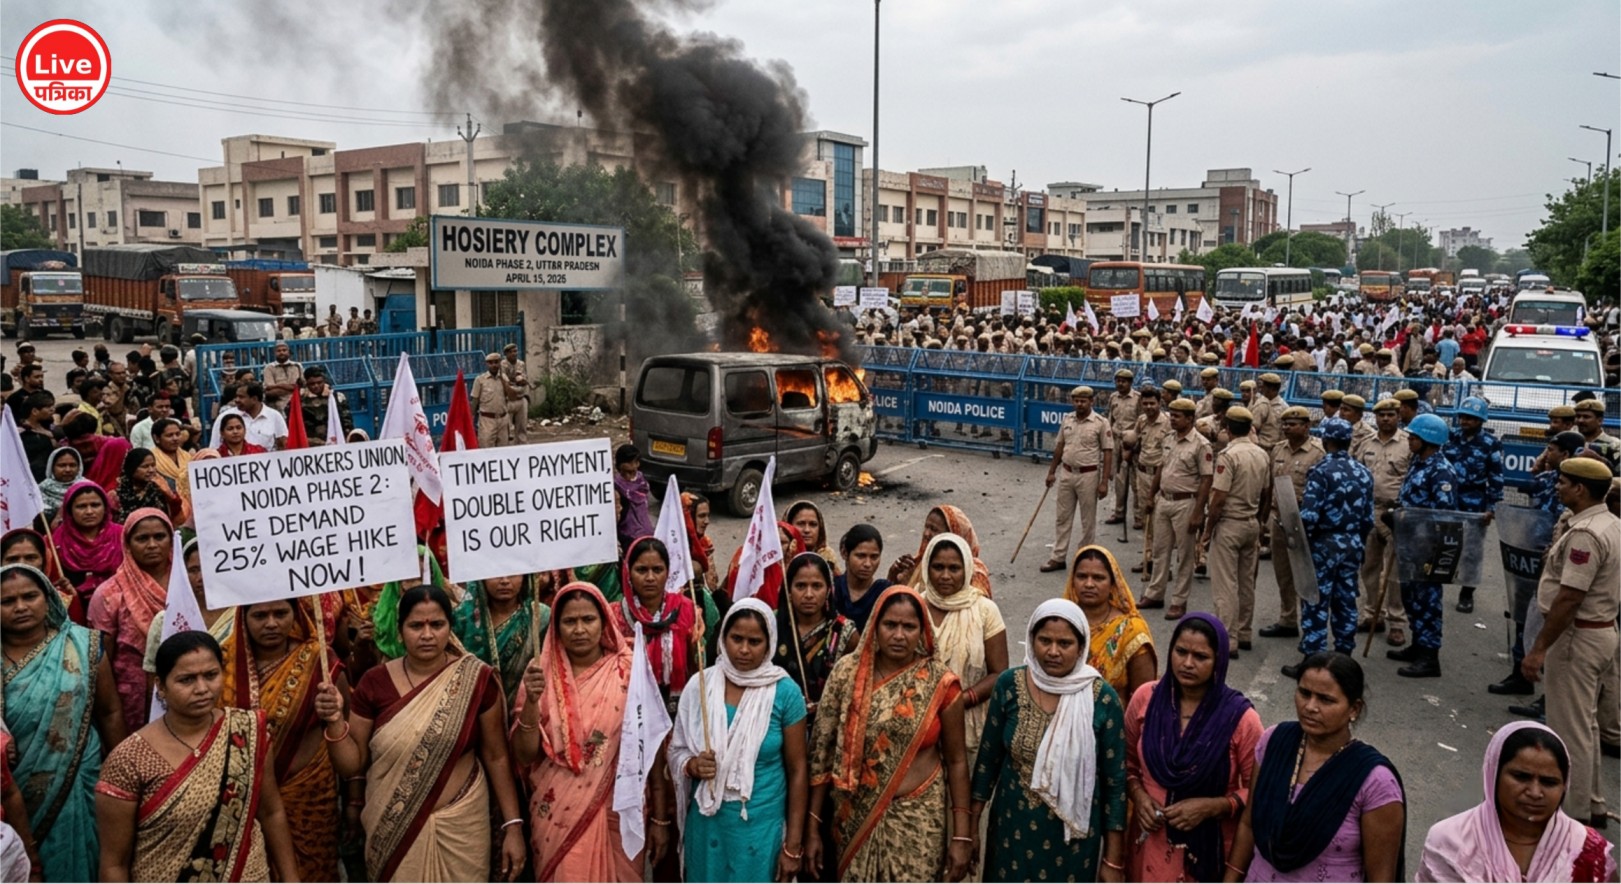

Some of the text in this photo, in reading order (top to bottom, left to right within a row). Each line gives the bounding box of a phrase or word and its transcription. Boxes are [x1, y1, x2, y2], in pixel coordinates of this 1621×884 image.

[442, 225, 617, 258] HOSIERY COMPLEX
[464, 257, 494, 269] NOIDA
[495, 258, 525, 270] PHASE
[526, 259, 534, 271] 2,
[505, 272, 531, 284] APRIL
[533, 273, 546, 285] 15,
[875, 394, 898, 408] LICE
[928, 400, 1005, 419] NOIDA POLICE
[194, 444, 409, 490] HOSIERY WORKERS UNION,
[448, 449, 611, 486] TIMELY PAYMENT,
[241, 485, 301, 511] NOIDA
[307, 476, 364, 501] PHASE
[452, 481, 612, 521] DOUBLE OVERTIME
[222, 505, 365, 542] WE DEMAND
[462, 513, 602, 552] IS OUR RIGHT.
[213, 525, 398, 573] 25% WAGE HIKE
[1509, 552, 1541, 574] RAF
[288, 556, 365, 592] NOW!
